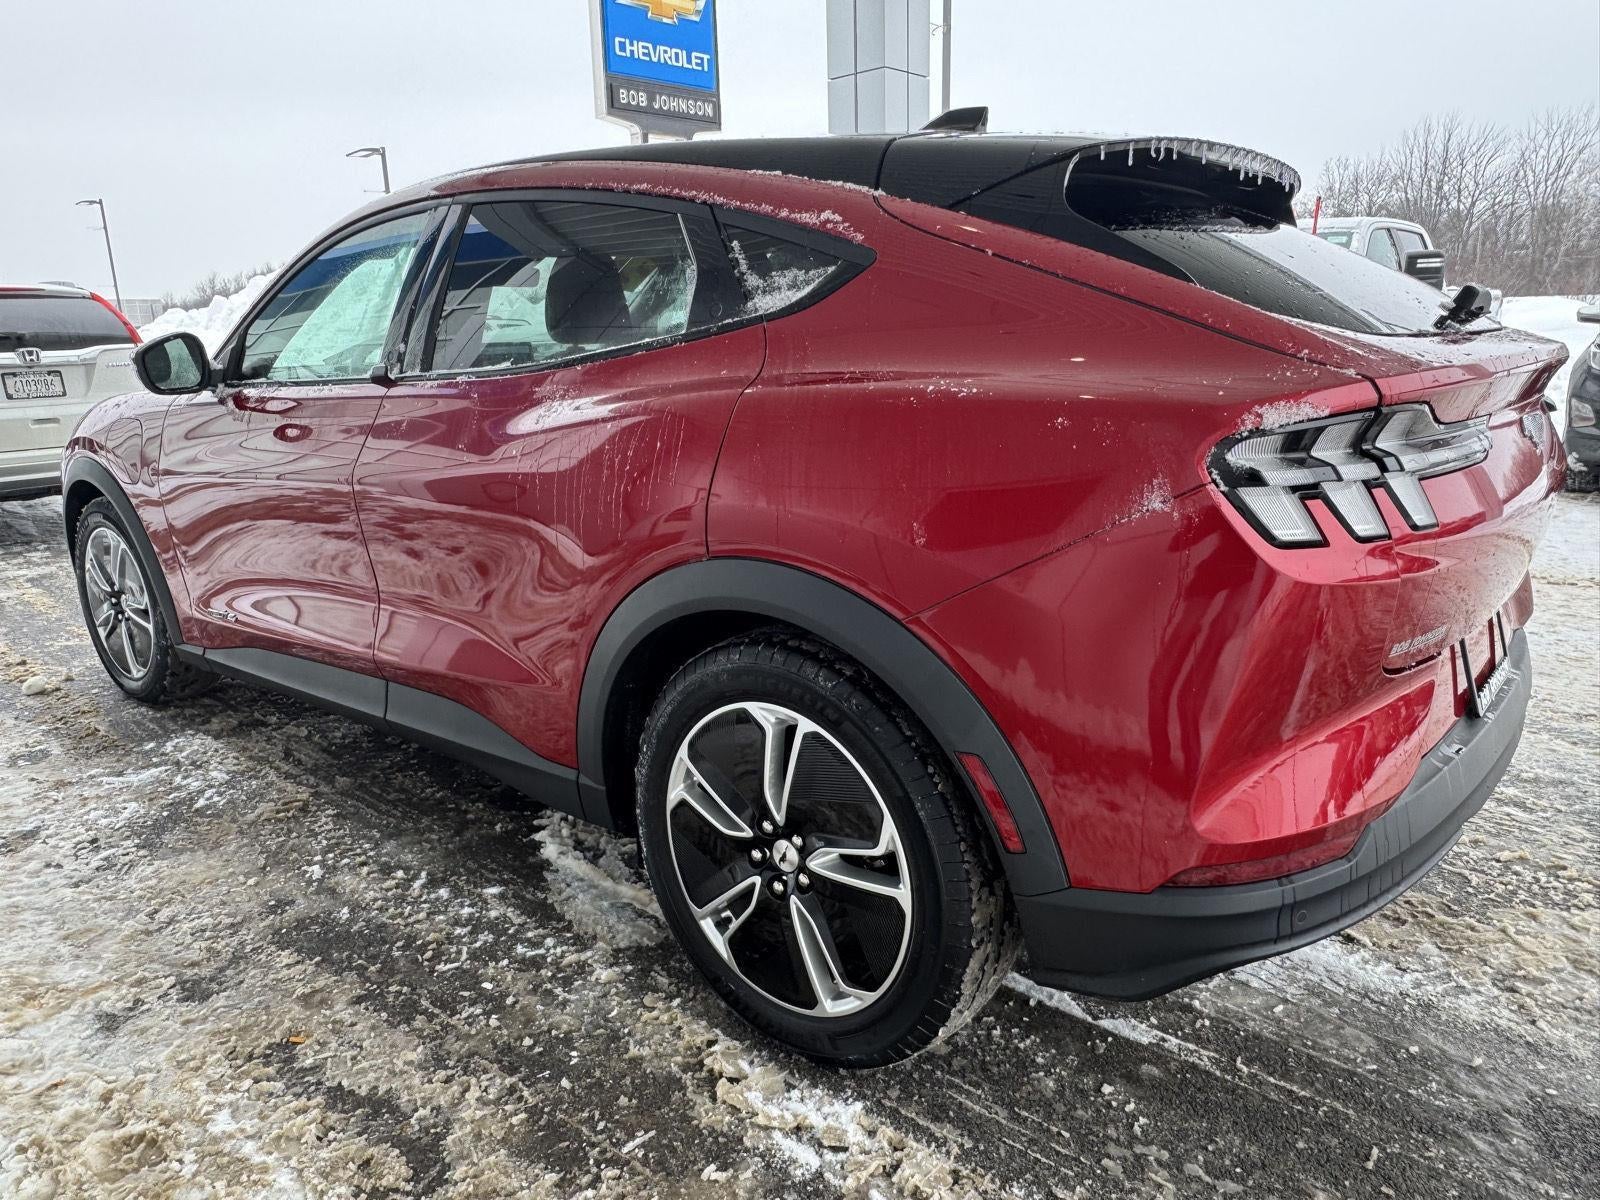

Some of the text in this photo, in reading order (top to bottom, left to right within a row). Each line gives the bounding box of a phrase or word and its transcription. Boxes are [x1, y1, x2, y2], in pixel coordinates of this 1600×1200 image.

[614, 36, 711, 72] CHEVROLET
[619, 89, 714, 118] BOB JOHNSON
